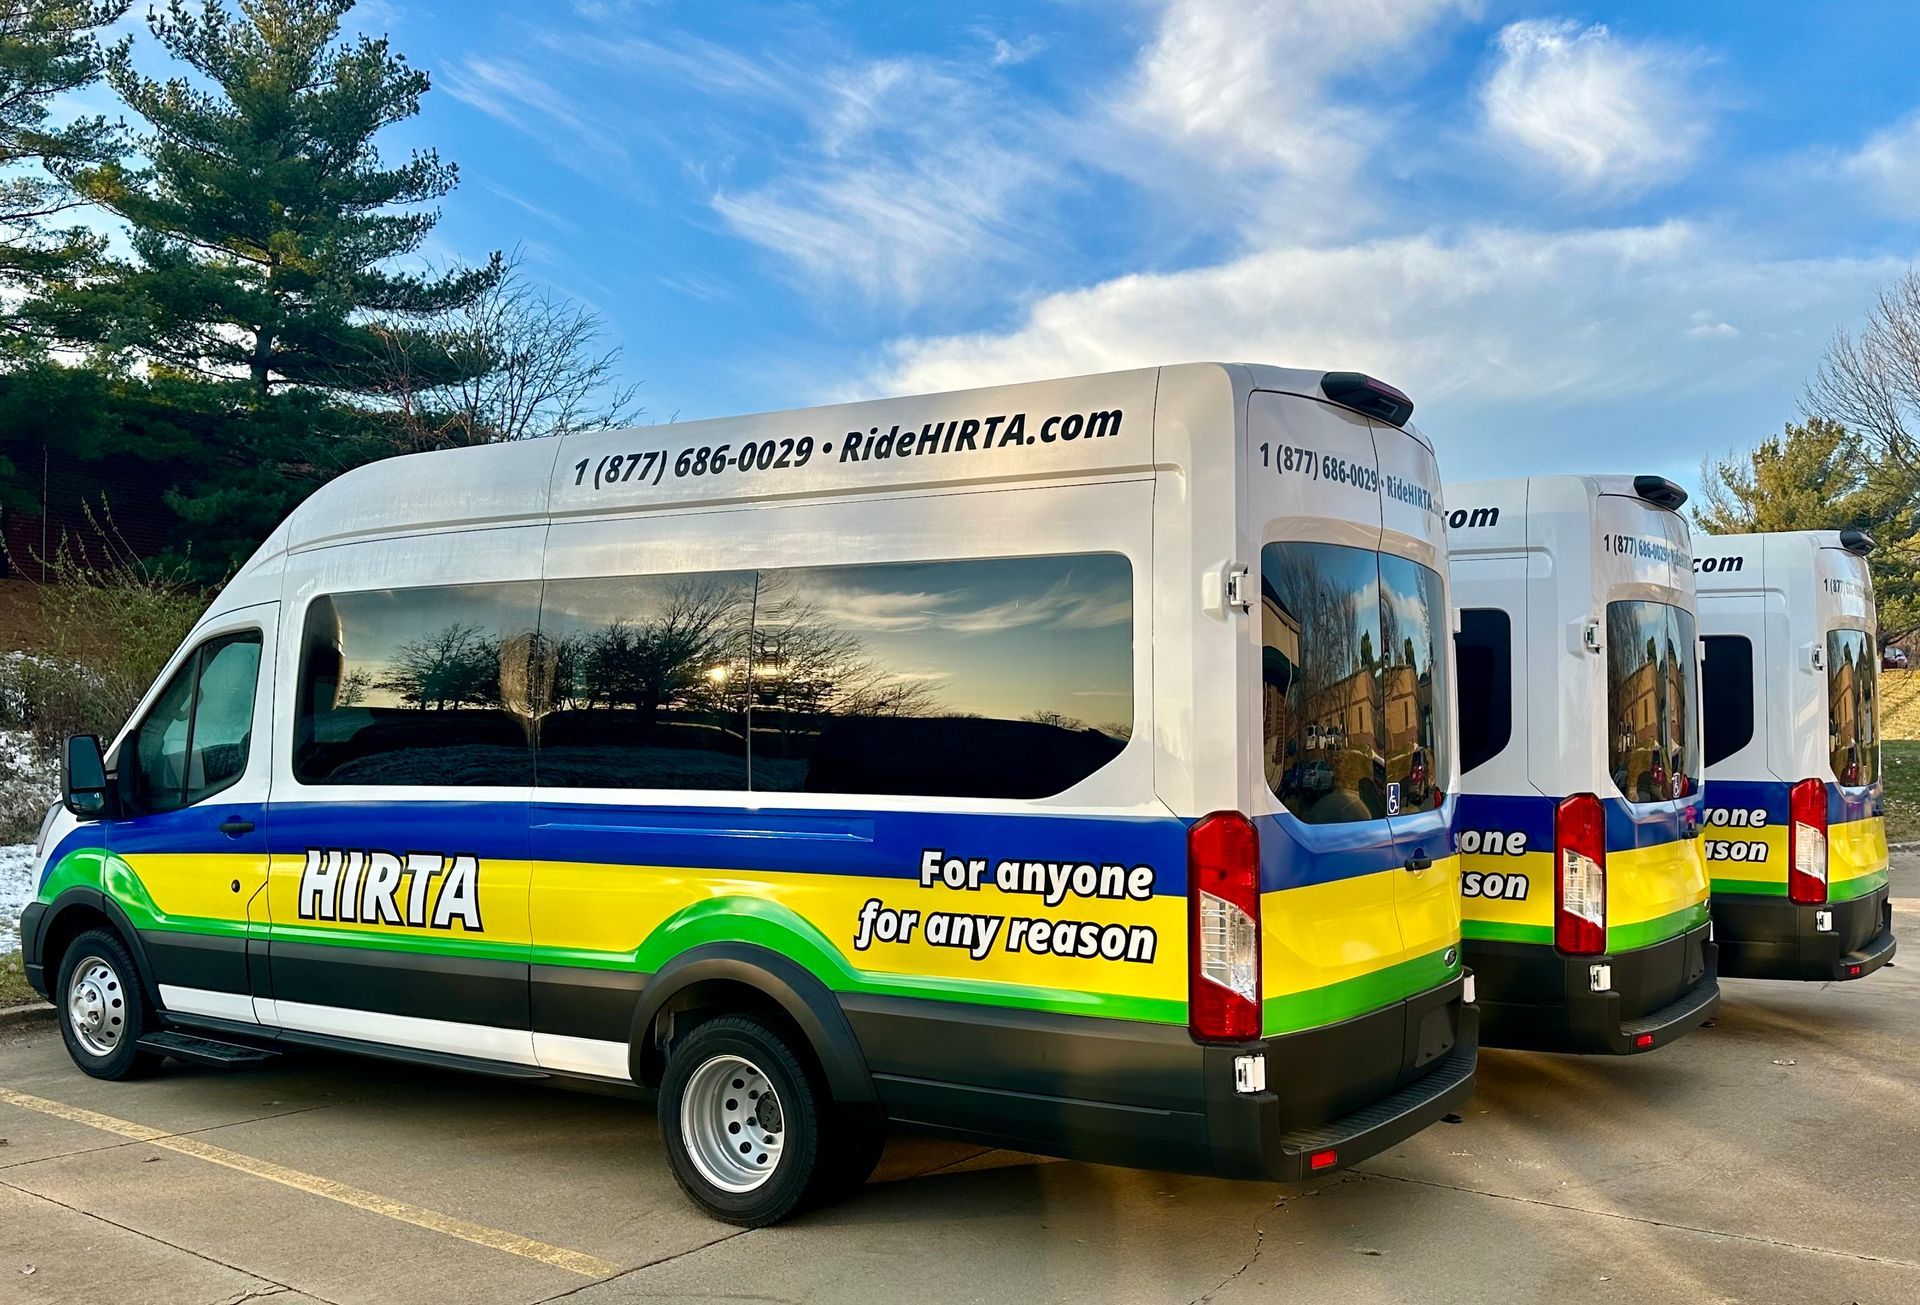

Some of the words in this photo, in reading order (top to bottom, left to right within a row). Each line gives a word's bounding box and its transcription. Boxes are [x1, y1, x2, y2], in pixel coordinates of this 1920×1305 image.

[575, 458, 589, 486] 1
[594, 450, 667, 490] (877)
[674, 436, 814, 478] 686-0029
[839, 409, 1123, 463] RideHIRTA.com
[1260, 442, 1269, 467] 1
[1276, 444, 1319, 481] (877)
[1322, 455, 1378, 493] 686-0029
[1386, 475, 1444, 520] RideHIRTA.
[1445, 506, 1500, 529] om
[1604, 534, 1610, 552] 1
[1613, 534, 1637, 558] (877)
[298, 845, 484, 932] HIRTA
[920, 847, 986, 891] For
[995, 857, 1154, 908] anyone
[1460, 870, 1530, 901] son
[854, 898, 920, 951] for
[924, 912, 1006, 961] any
[1005, 916, 1158, 964] reason
